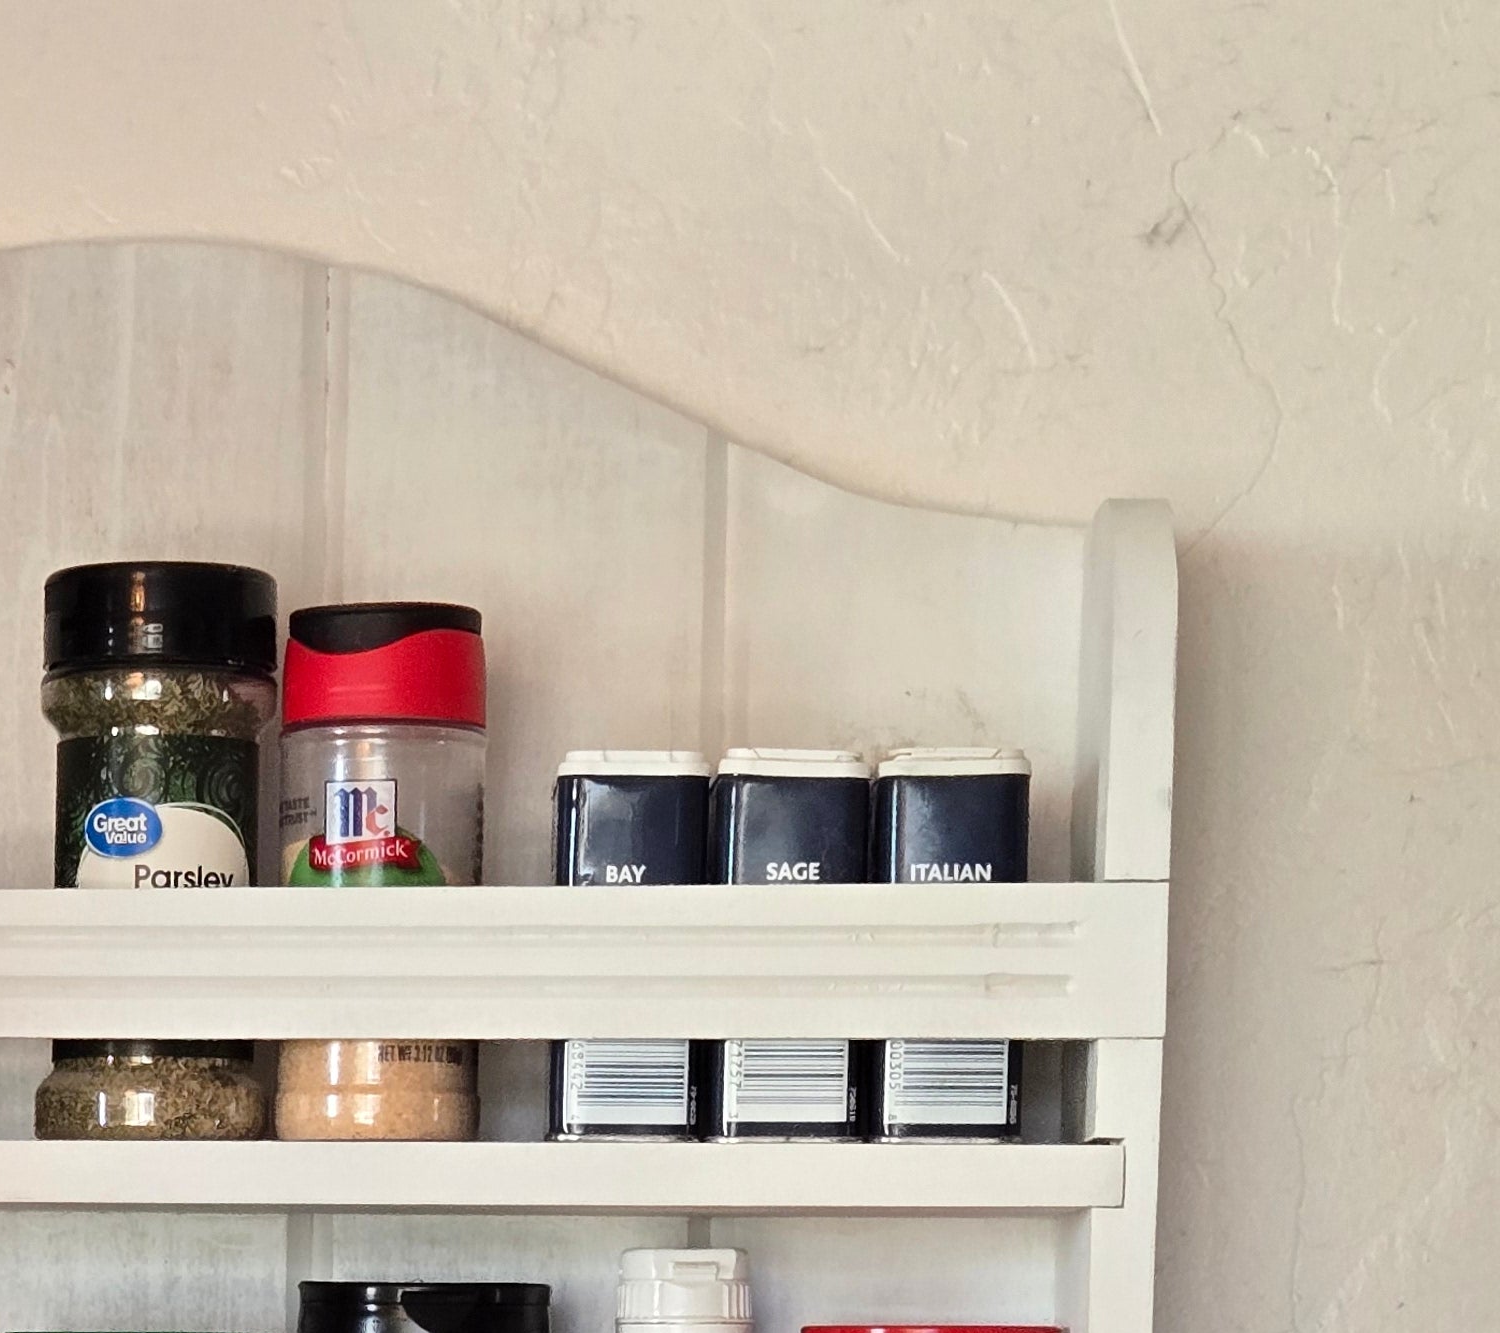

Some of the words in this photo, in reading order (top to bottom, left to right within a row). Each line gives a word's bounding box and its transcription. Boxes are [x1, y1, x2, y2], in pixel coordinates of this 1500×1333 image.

[93, 811, 148, 833] Great
[105, 829, 148, 846] Value
[313, 843, 409, 867] McCormick
[134, 864, 235, 889] Parsley
[605, 864, 646, 884] BAY
[765, 862, 821, 882] SAGE
[910, 862, 993, 883] ITALIAN
